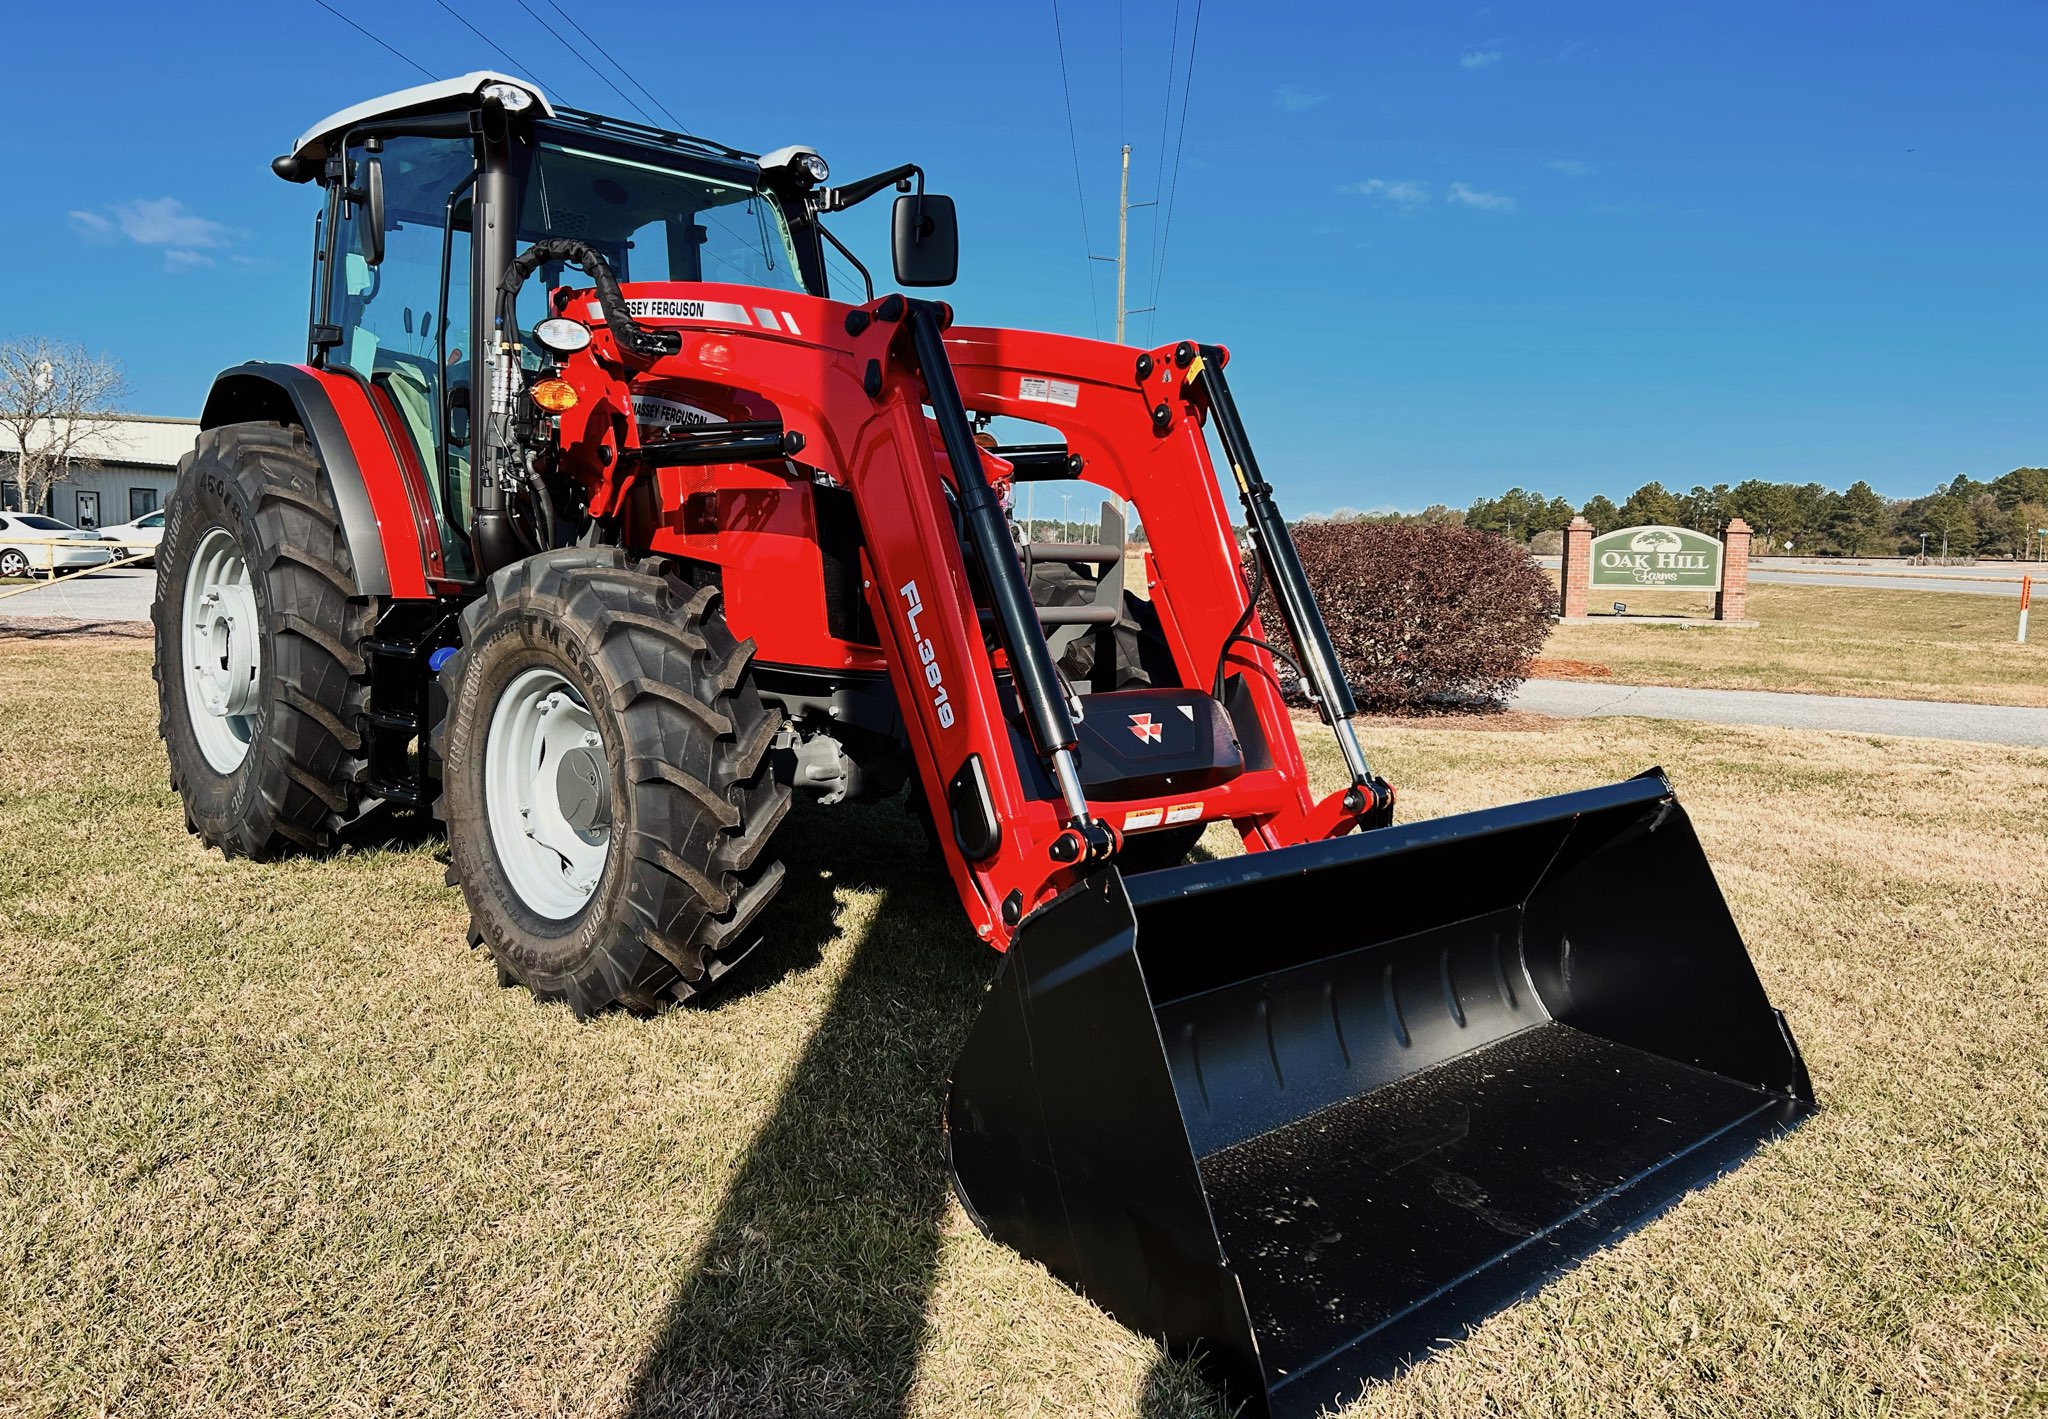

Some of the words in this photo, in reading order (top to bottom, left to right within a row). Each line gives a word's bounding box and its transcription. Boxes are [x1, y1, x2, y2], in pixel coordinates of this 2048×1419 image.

[651, 301, 704, 318] FERGUSON
[661, 405, 708, 425] FERGUSON
[1601, 552, 1650, 569] OAK
[1657, 553, 1710, 569] HILL
[1632, 567, 1677, 583] Farms
[524, 614, 560, 647] TM
[565, 639, 605, 710] 600
[900, 580, 955, 729] FL.3819
[448, 652, 483, 773] TRELLEBORG
